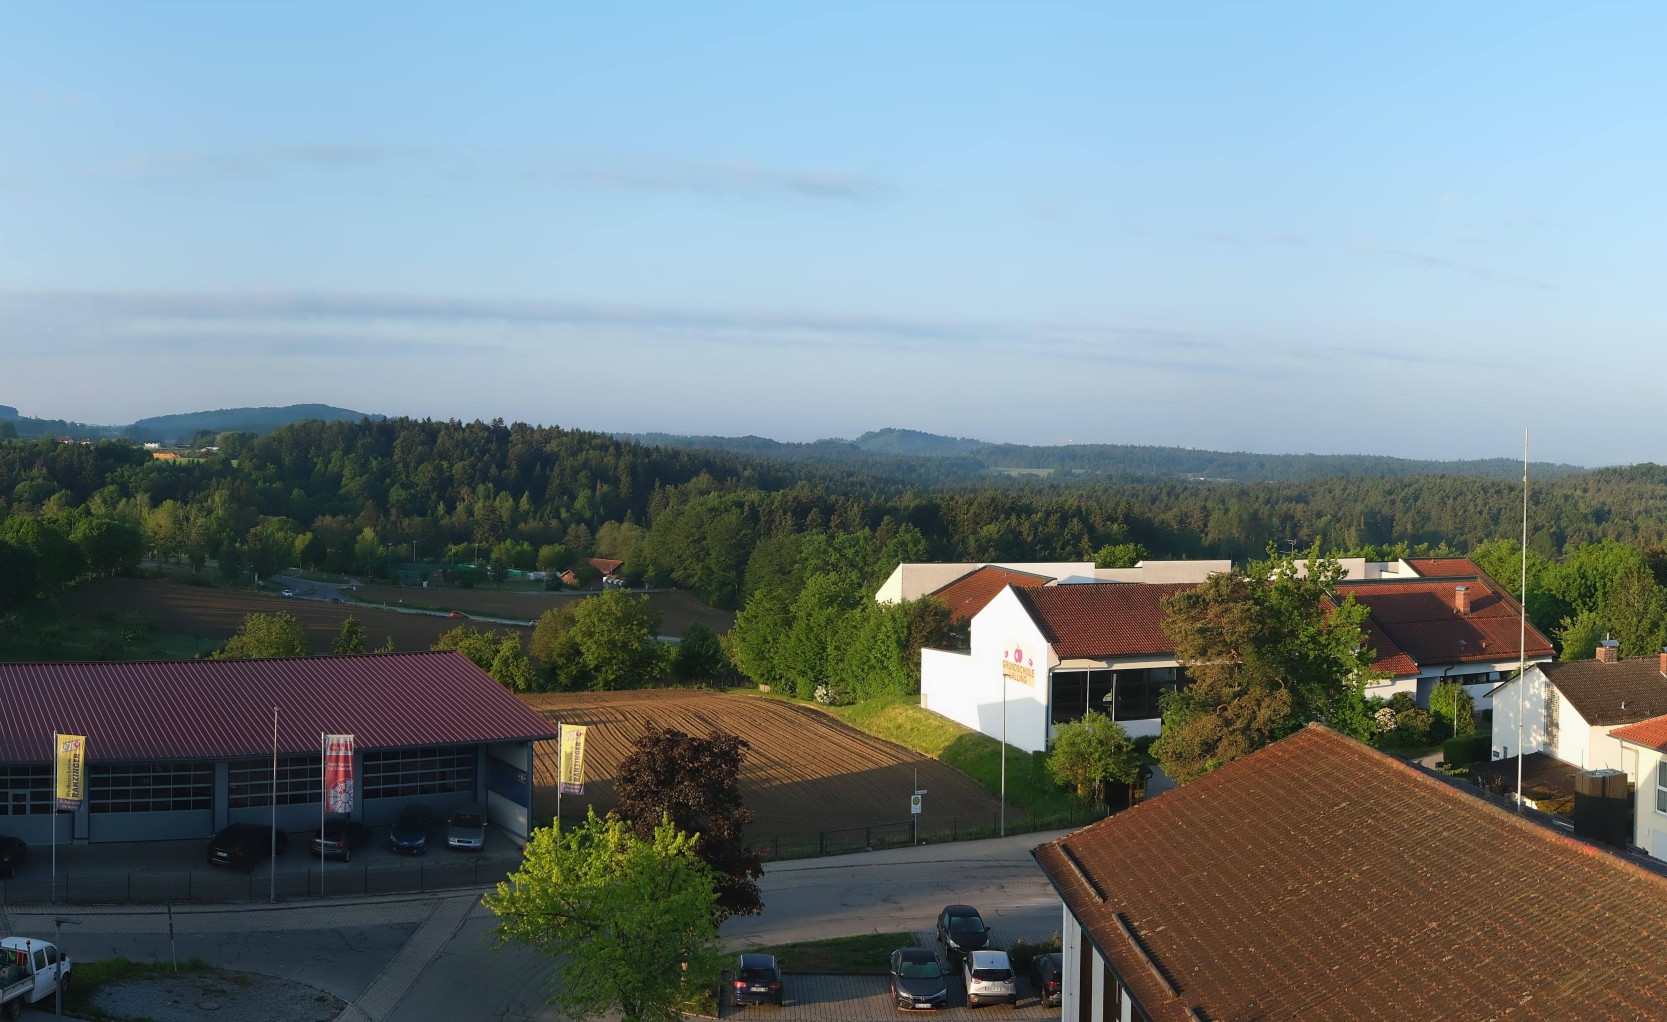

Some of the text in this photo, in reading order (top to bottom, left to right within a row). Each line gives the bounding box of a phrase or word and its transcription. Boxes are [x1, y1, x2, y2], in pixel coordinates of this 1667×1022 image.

[1002, 660, 1035, 678] GRUNDSCHULE
[72, 753, 80, 798] RANZINGER
[573, 741, 582, 782] RANZINGER
